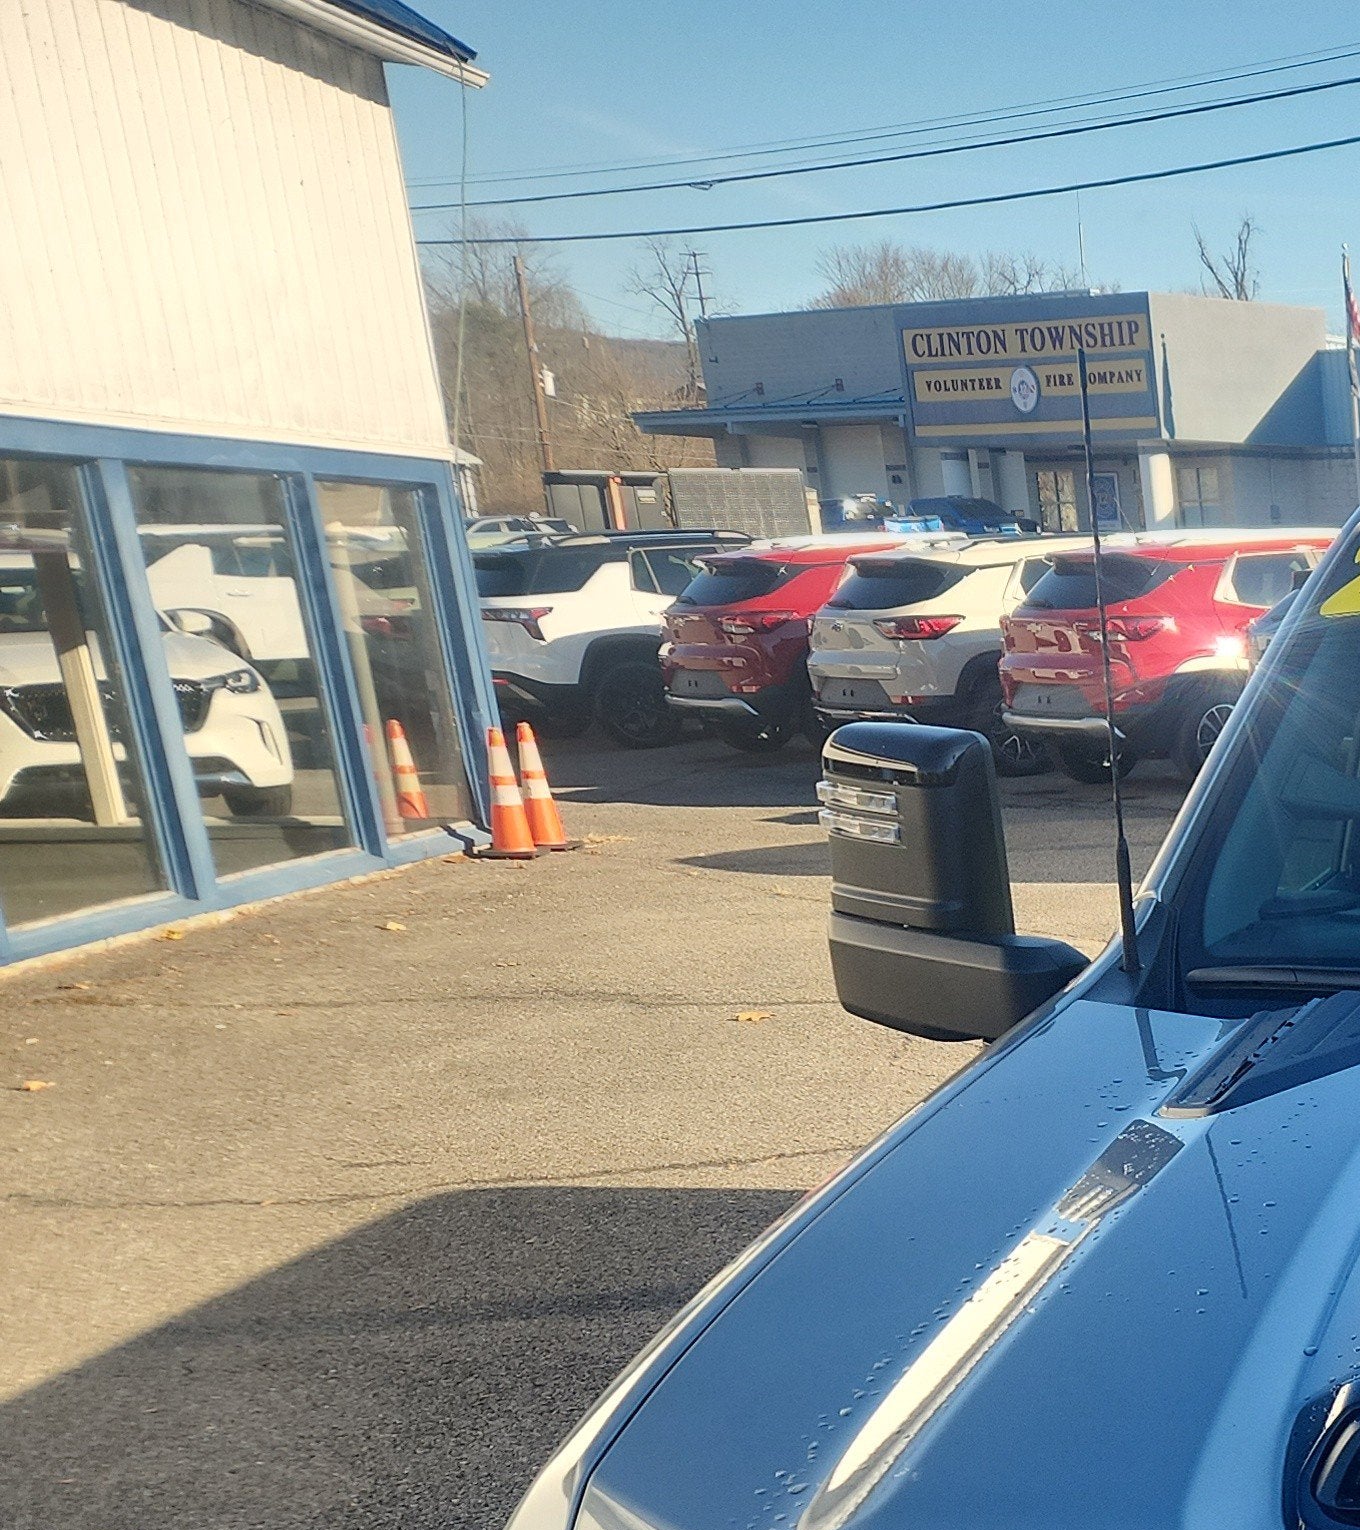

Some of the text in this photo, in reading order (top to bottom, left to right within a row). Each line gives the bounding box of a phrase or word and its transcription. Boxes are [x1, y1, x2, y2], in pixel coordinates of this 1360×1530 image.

[912, 320, 1140, 358] CLINTON TOWNSHIP
[925, 369, 1143, 392] VOLUNTEER FIRE OMPANY
